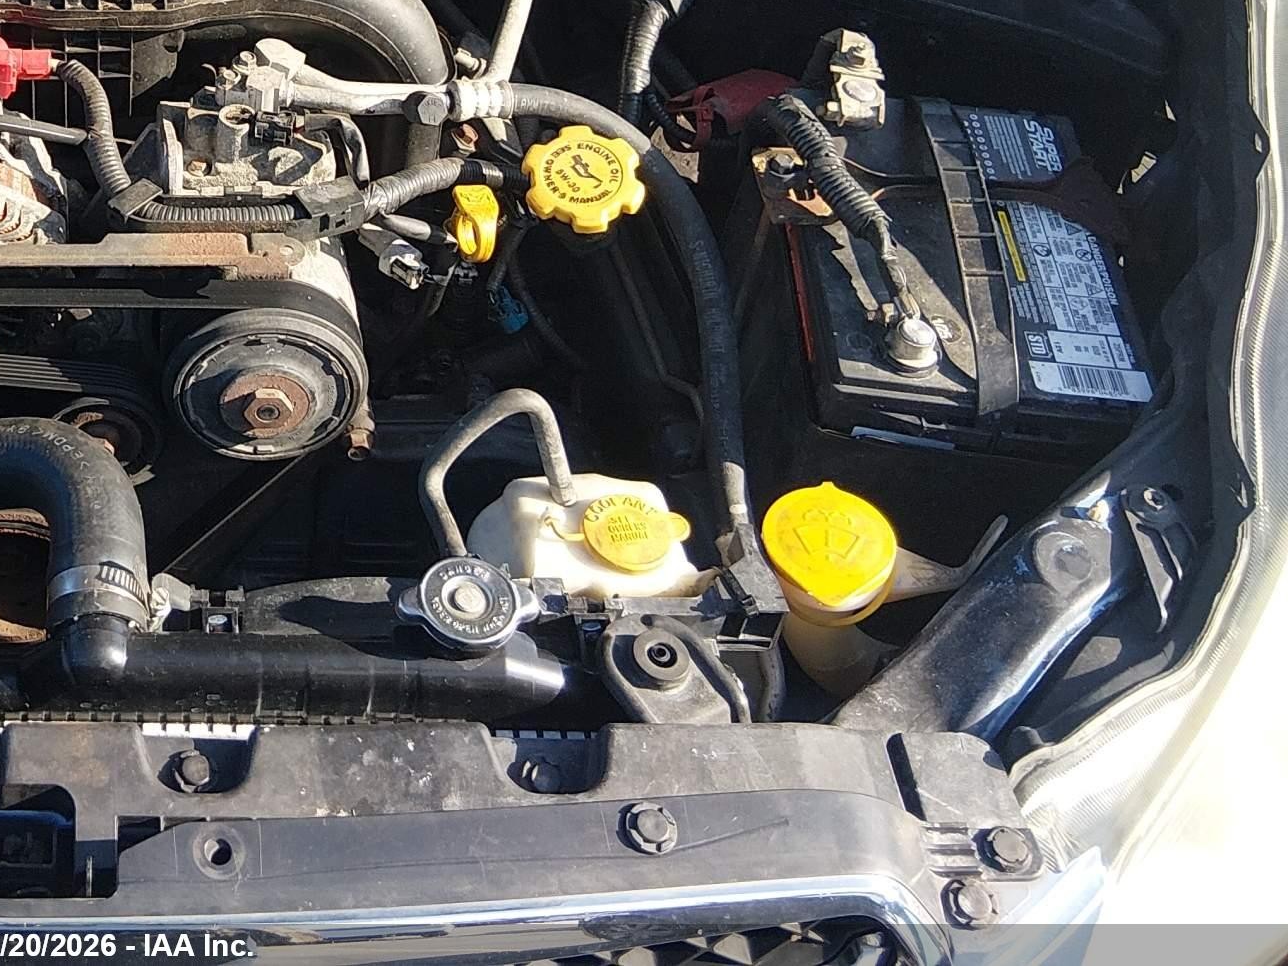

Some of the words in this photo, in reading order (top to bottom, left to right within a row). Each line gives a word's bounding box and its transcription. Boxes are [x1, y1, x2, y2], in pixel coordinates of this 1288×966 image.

[577, 142, 616, 166] ENGINE
[608, 167, 621, 183] OIL
[1023, 119, 1052, 171] START
[1042, 127, 1063, 172] SUPER
[553, 144, 572, 159] SEE
[568, 189, 613, 204] MANUAL
[1087, 235, 1107, 272] DANGER
[1101, 271, 1119, 305] POISON
[1028, 334, 1046, 354] STD
